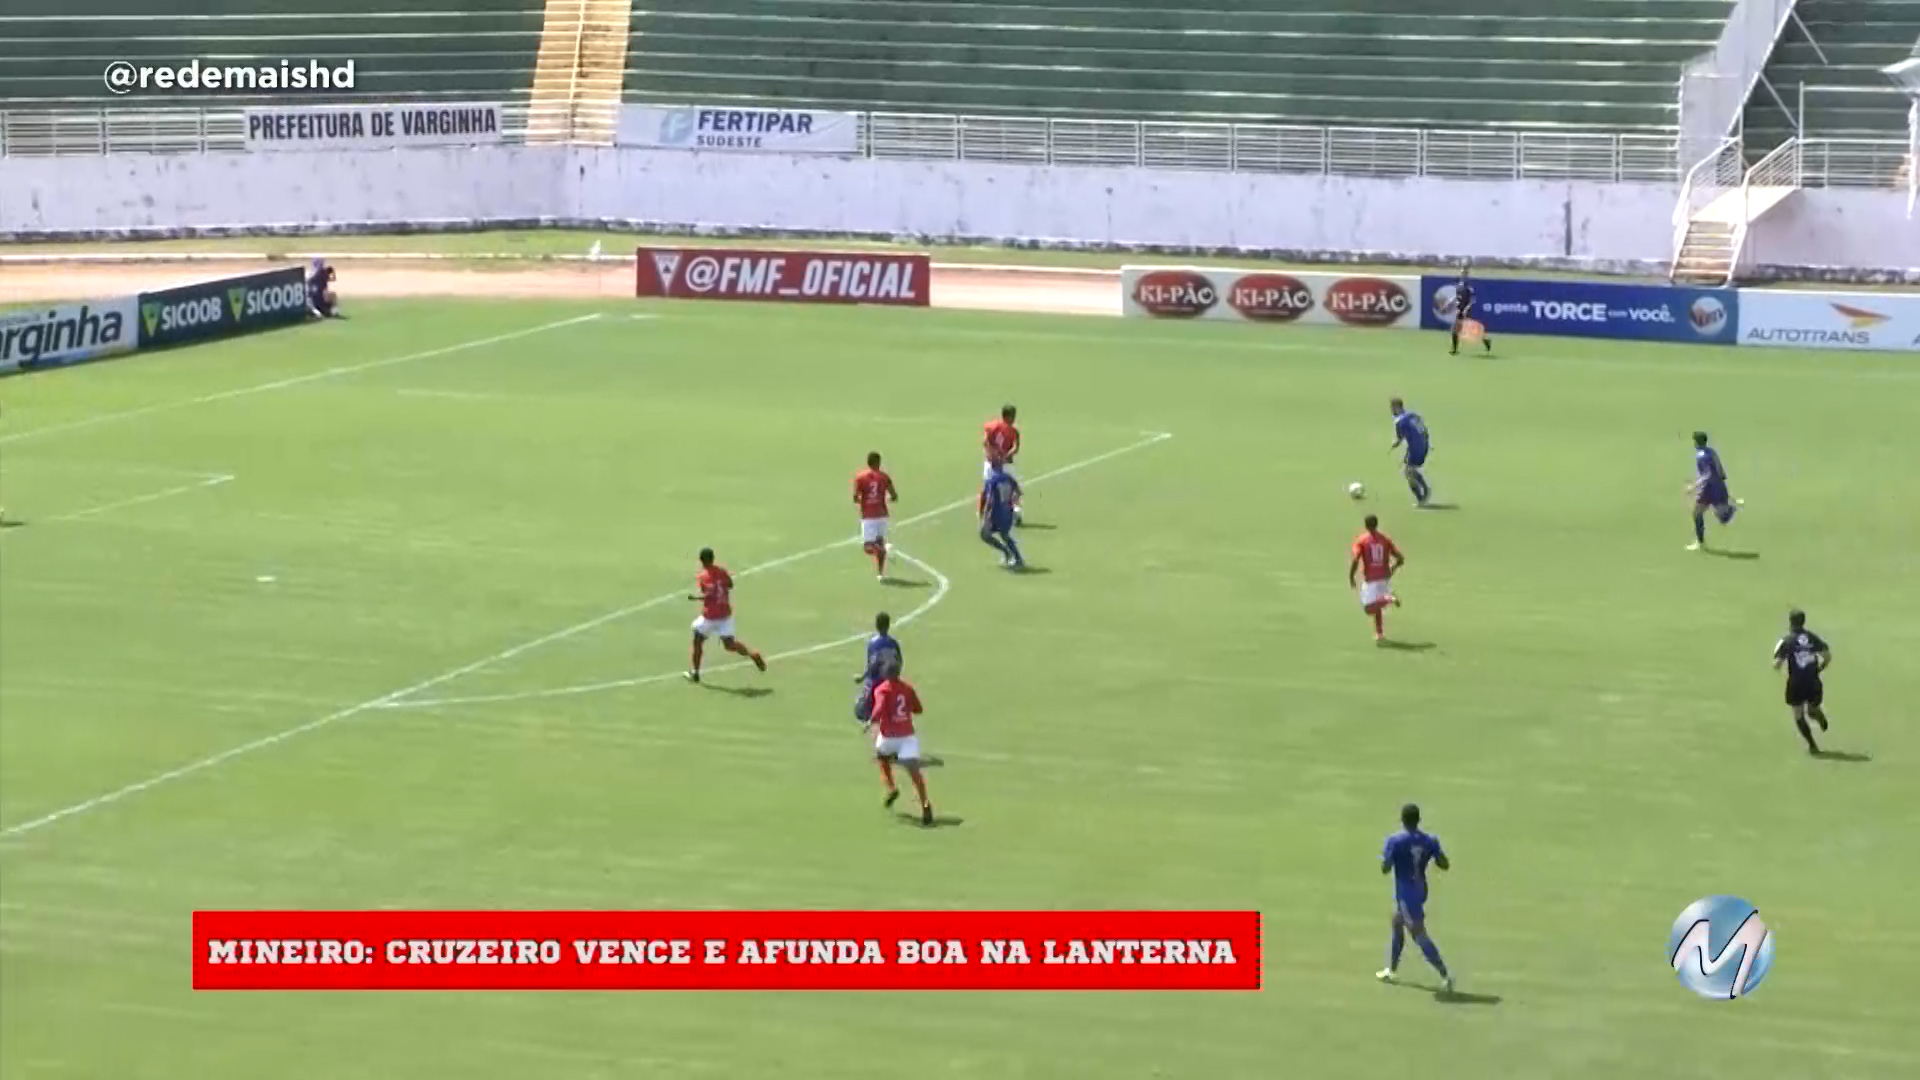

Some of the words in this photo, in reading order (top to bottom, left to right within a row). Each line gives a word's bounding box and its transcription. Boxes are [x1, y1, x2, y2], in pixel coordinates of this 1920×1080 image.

[249, 111, 365, 140] PREFEITURA
[371, 111, 395, 137] DE
[401, 107, 497, 136] VARGINHA
[697, 110, 814, 134] FERTIPAR
[696, 135, 762, 148] SUDESTE
[685, 256, 916, 299] @FMF_OFICIAL
[246, 282, 305, 315] SICOOB
[1139, 282, 1214, 305] KI-PÃO
[1235, 284, 1311, 309] KI-PÃO
[1331, 289, 1408, 312] KI-PÃO
[161, 296, 222, 330] SICOOB
[1531, 301, 1608, 322] TORCE
[0, 305, 123, 368] rginha
[1747, 327, 1871, 345] AUTOTRANS
[1370, 543, 1384, 561] 10
[896, 693, 906, 716] 2
